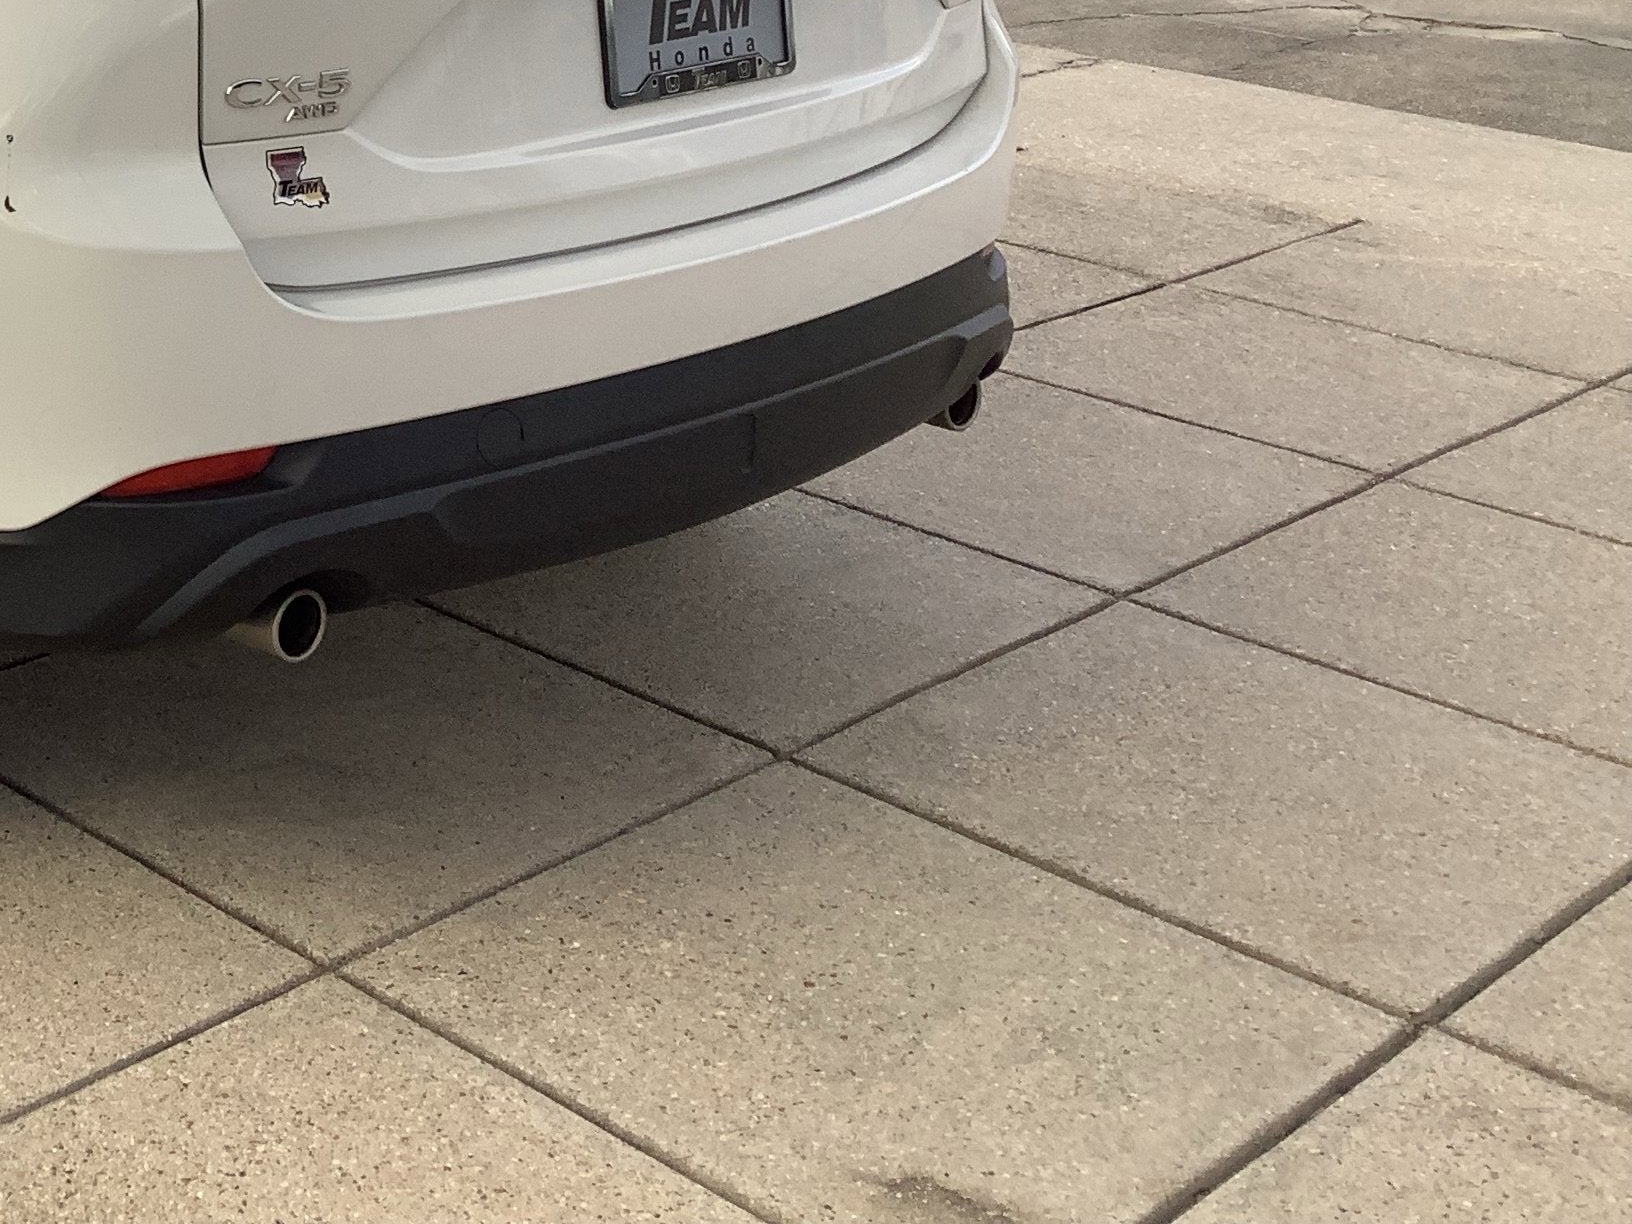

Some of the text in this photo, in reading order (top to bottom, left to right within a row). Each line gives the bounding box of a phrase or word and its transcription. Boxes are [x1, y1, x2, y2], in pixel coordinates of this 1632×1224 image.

[649, 37, 756, 72] Honda
[224, 68, 352, 110] CX-5
[278, 179, 319, 197] TEAM
